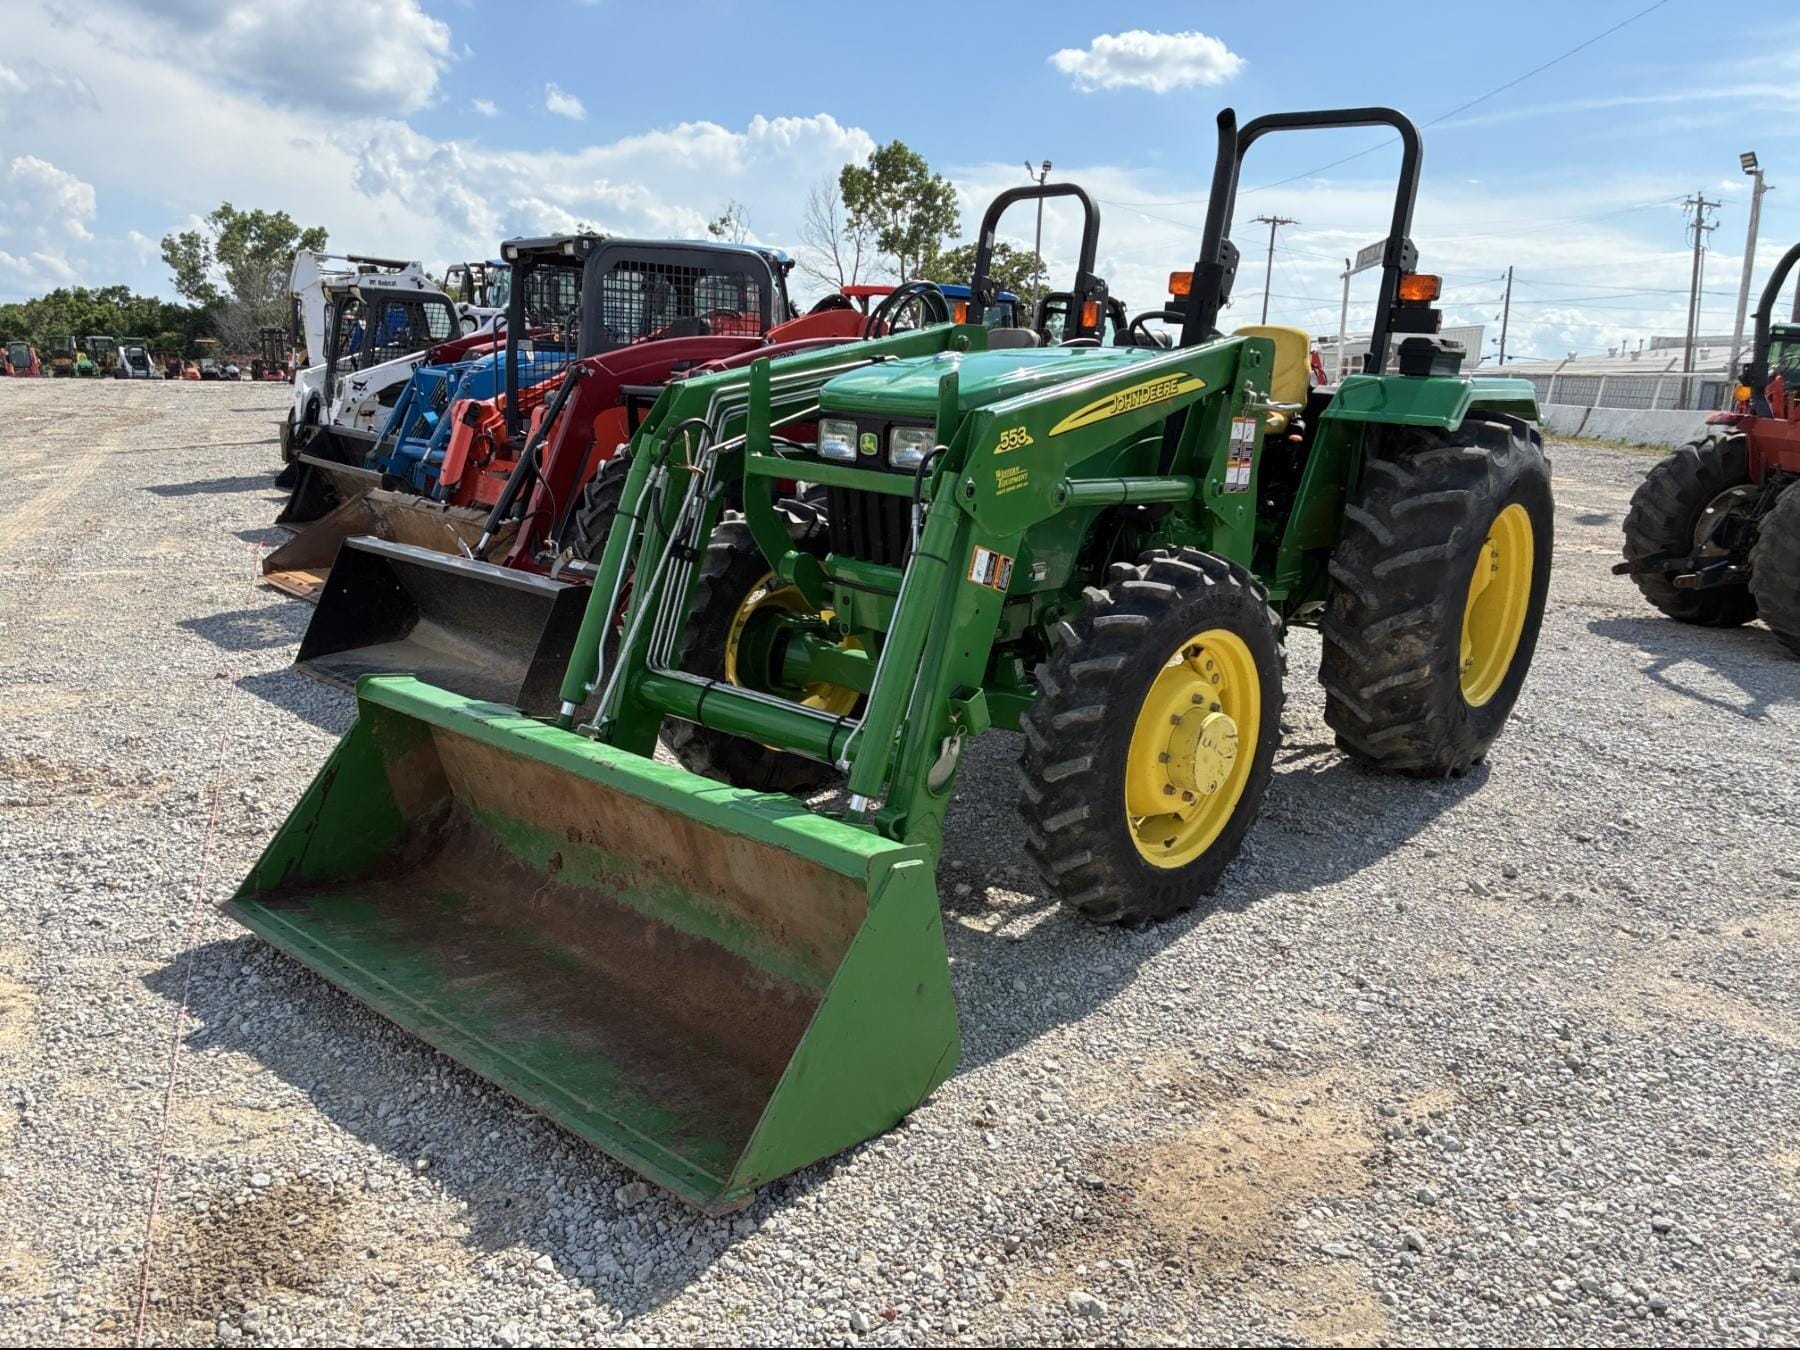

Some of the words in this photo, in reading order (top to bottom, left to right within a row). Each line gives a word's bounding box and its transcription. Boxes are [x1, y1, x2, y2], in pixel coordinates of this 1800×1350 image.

[378, 279, 397, 287] Bobcat
[1110, 389, 1141, 413] JOHN
[1141, 379, 1179, 403] DEERE
[1000, 426, 1027, 450] 553
